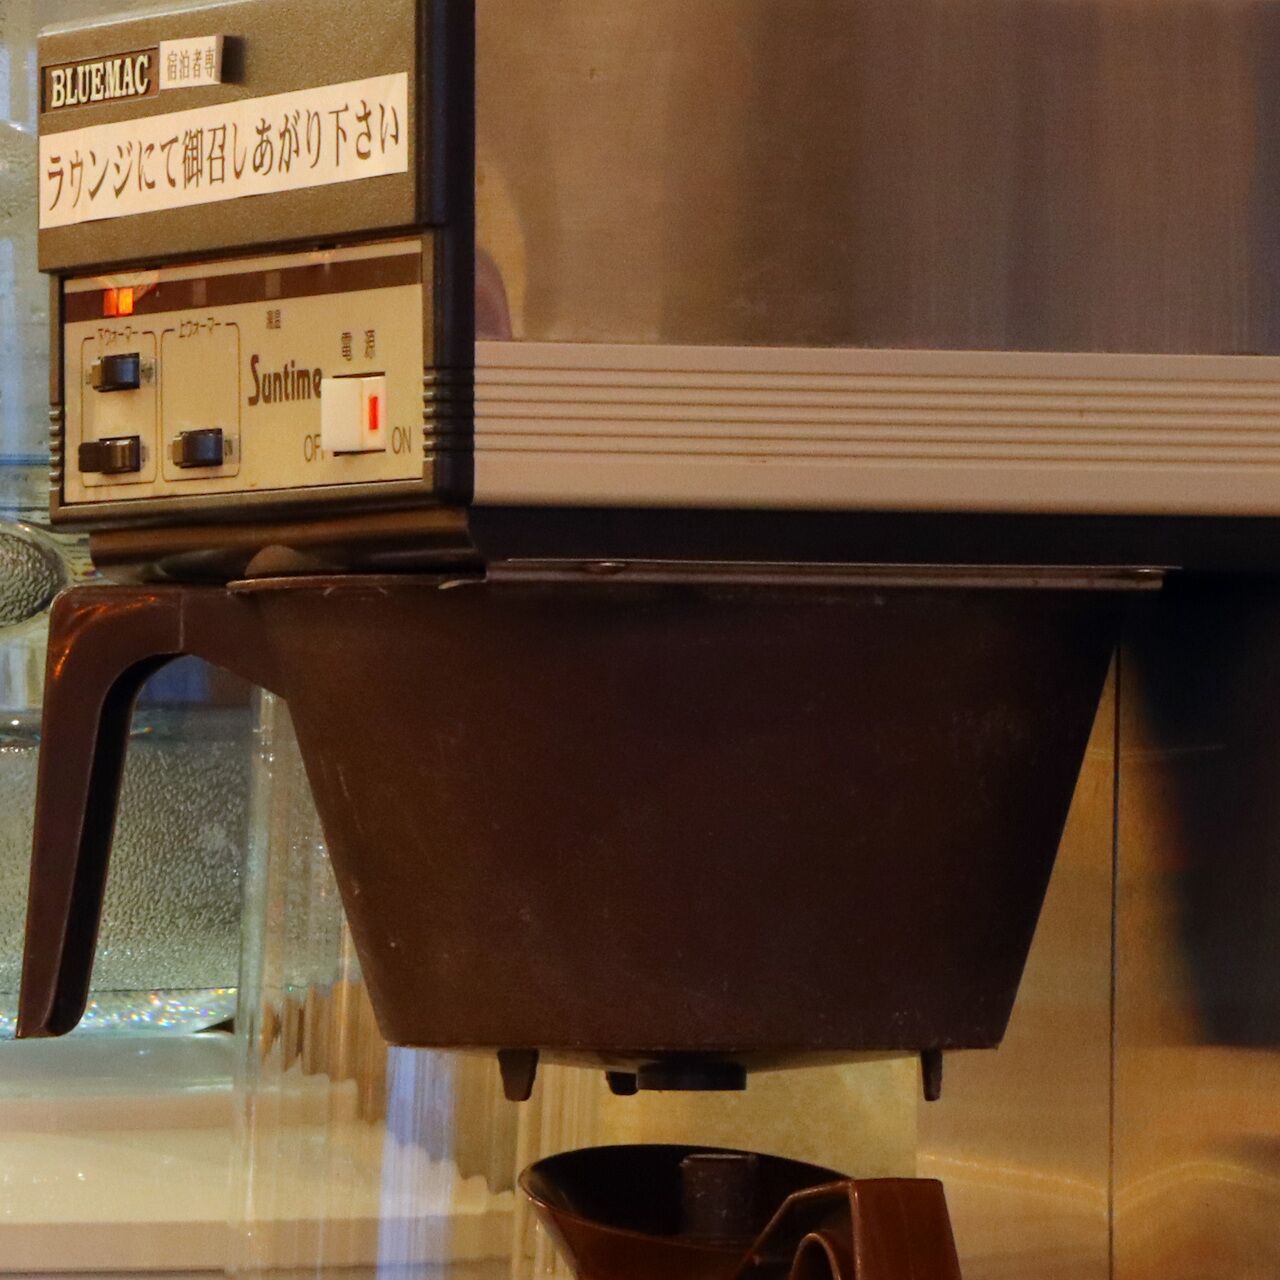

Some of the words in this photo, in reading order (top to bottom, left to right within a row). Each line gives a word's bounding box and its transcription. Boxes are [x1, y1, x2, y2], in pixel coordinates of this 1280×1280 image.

[51, 55, 150, 108] BLUEMAC
[47, 100, 400, 211] ラウンジにて御召しあがり下さい
[247, 354, 322, 406] Suntime
[304, 434, 324, 463] OF
[391, 426, 412, 455] ON
